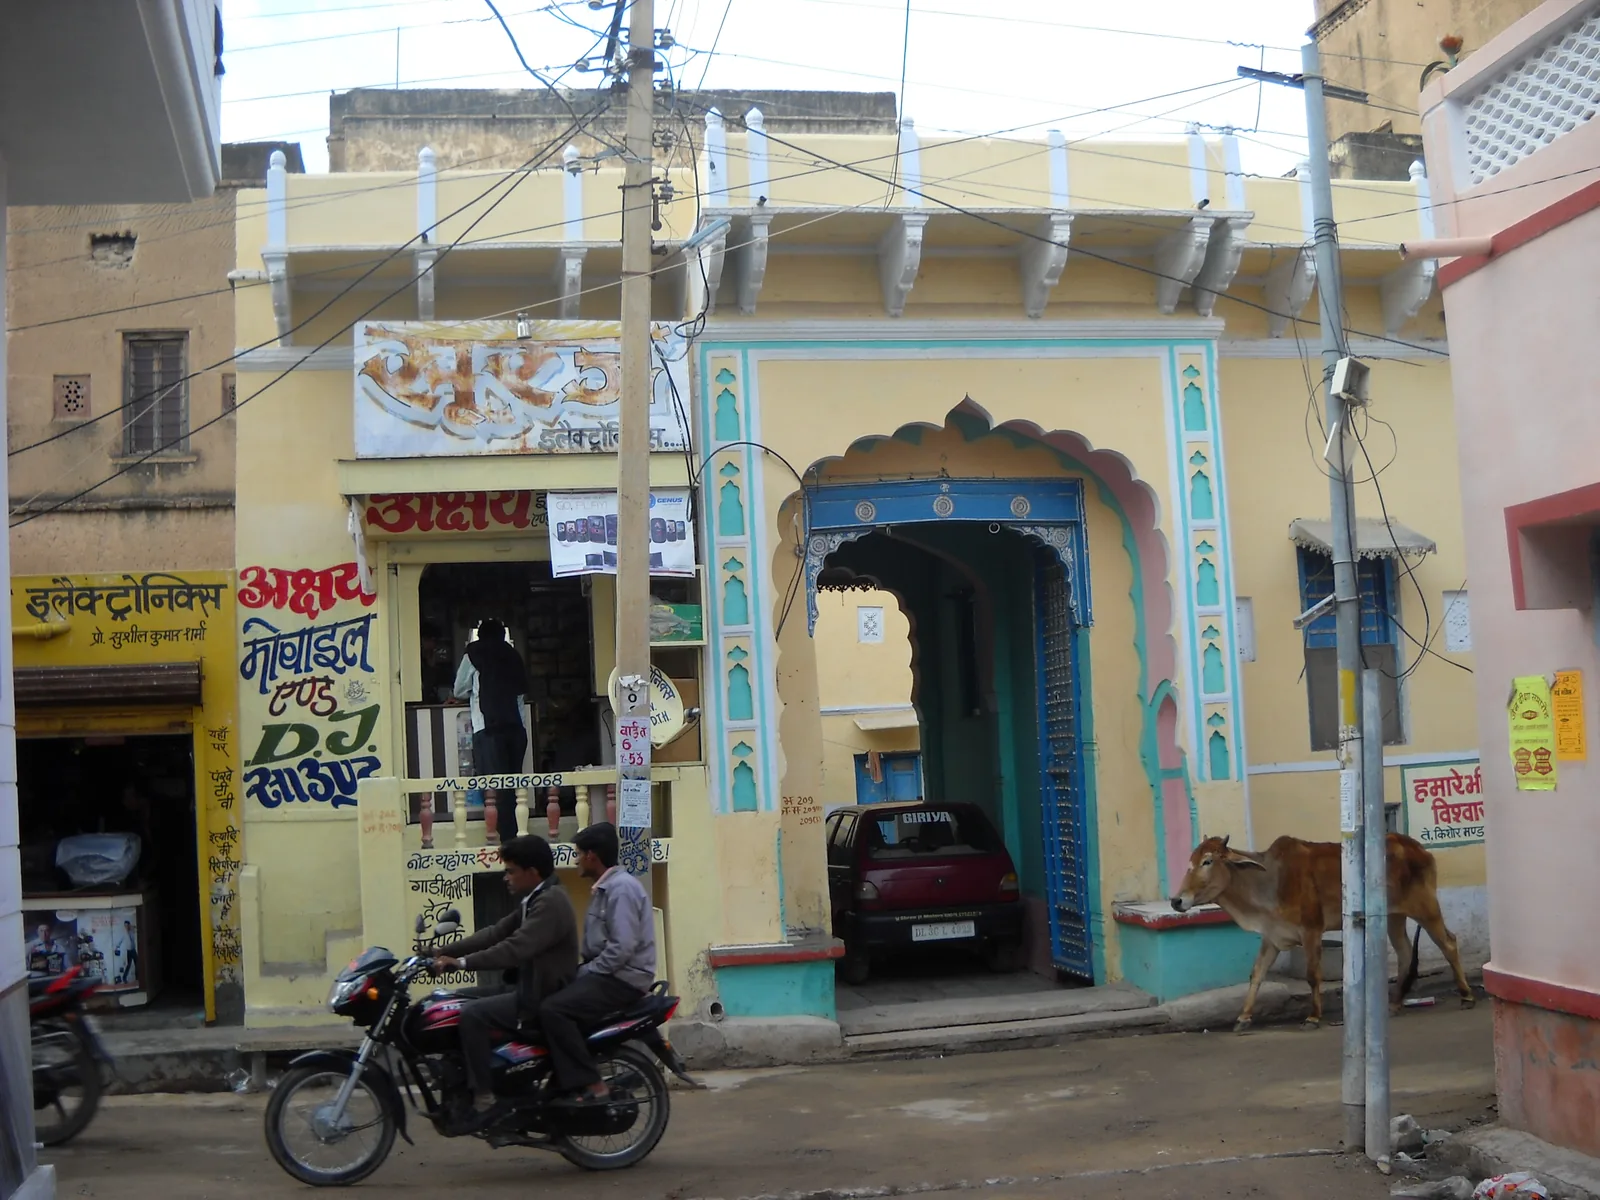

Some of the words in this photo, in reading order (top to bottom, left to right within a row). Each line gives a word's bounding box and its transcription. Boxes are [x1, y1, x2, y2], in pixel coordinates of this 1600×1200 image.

[366, 490, 531, 533] अक्षय
[238, 562, 377, 620] अक्षय
[109, 624, 148, 649] सुशील
[150, 629, 183, 646] कुमार
[184, 620, 207, 641] शर्मा
[211, 743, 229, 758] पर
[622, 739, 632, 750] 6
